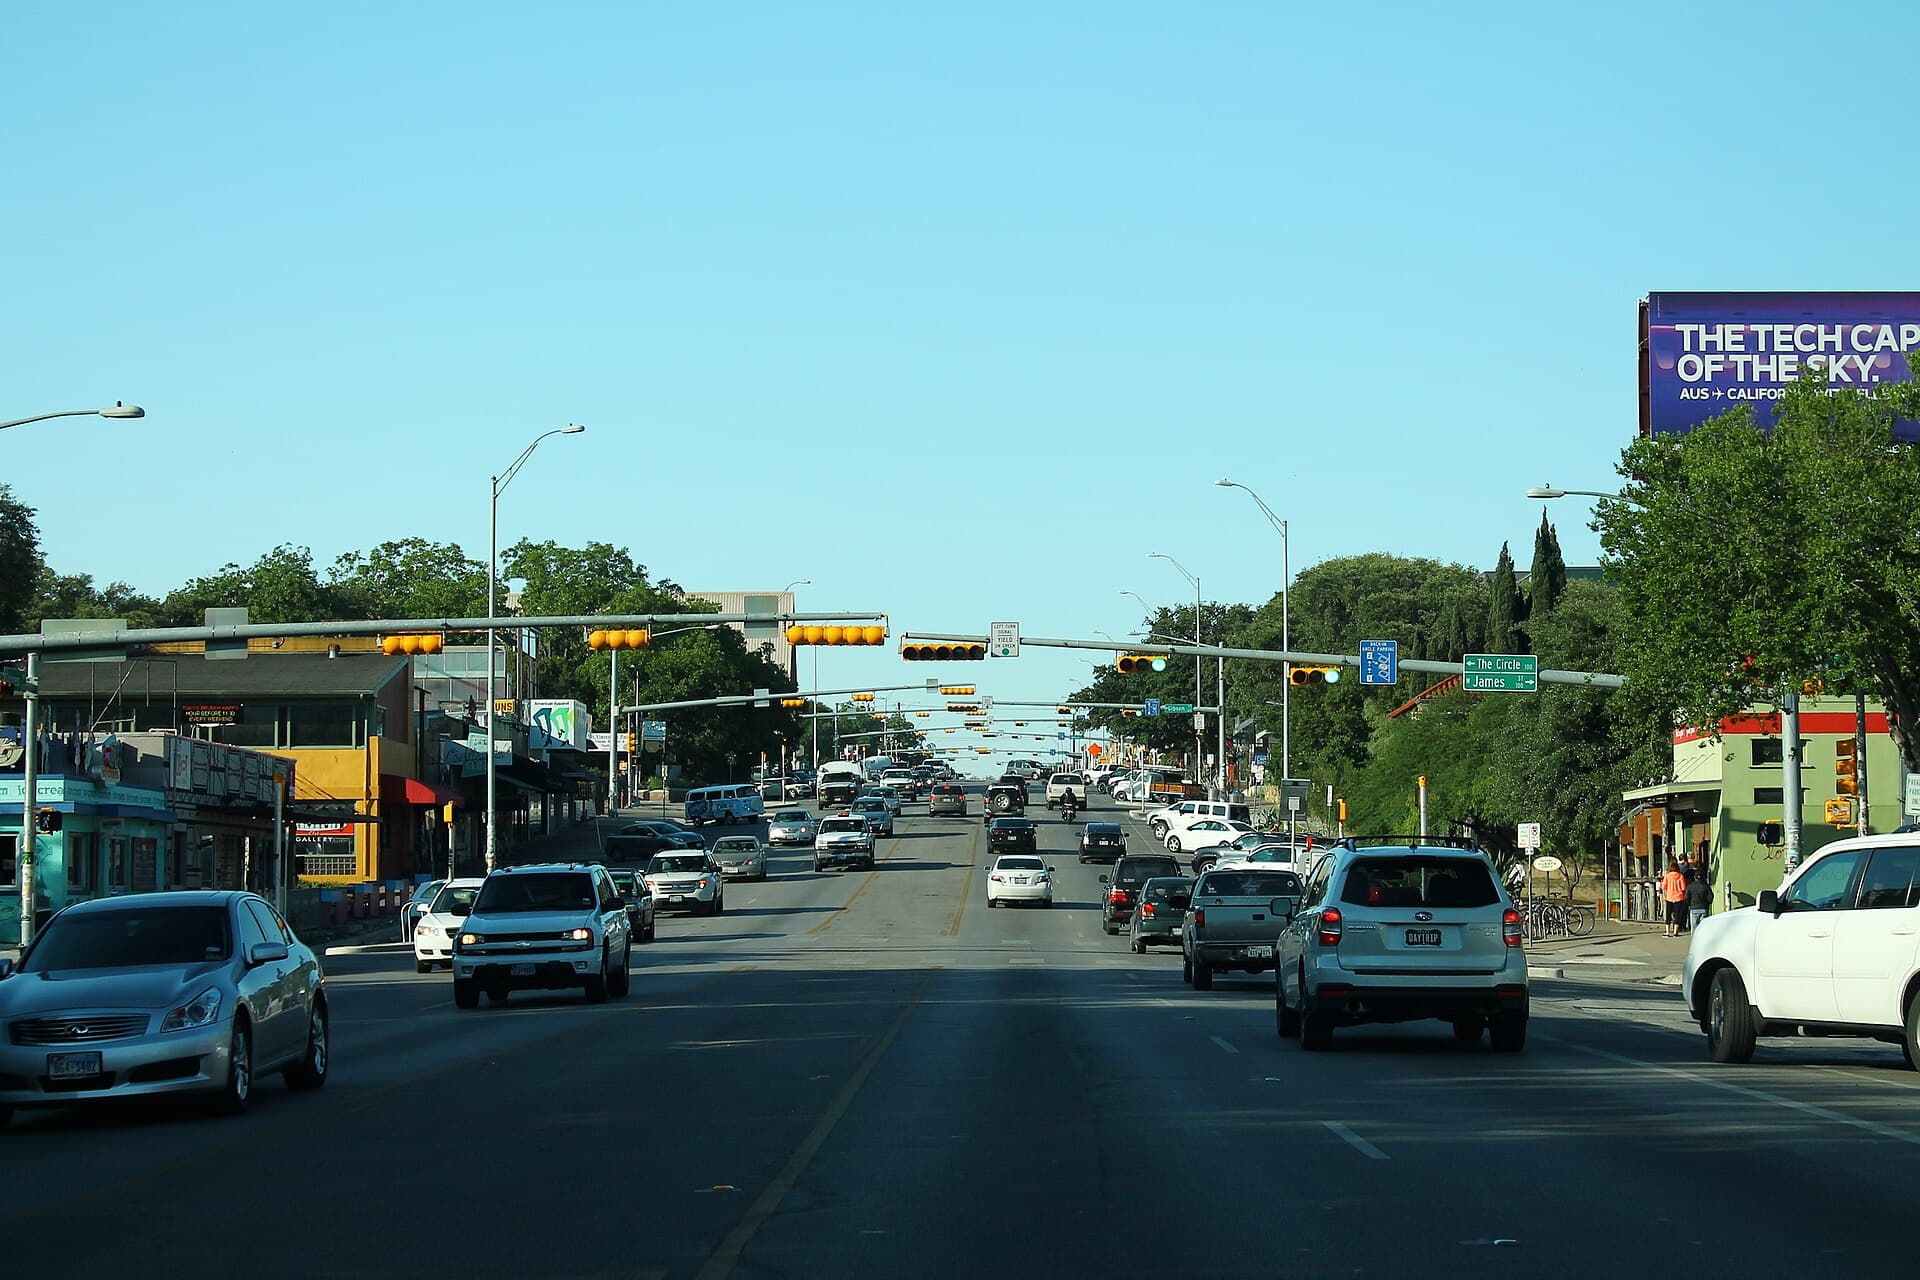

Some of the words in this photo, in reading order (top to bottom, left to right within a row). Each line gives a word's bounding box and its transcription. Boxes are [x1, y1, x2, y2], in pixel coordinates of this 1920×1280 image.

[1675, 324, 1745, 352] THE
[1750, 324, 1842, 352] TECH
[1850, 324, 1920, 352] CAP
[1677, 354, 1725, 382] OF
[1729, 354, 1799, 382] THE
[1806, 354, 1880, 382] SKY.
[1679, 388, 1709, 400] AUS
[1726, 388, 1797, 400] CALIFOR
[1477, 658, 1493, 670] The
[1496, 658, 1521, 670] Circle
[1473, 675, 1505, 688] James
[1408, 933, 1439, 943] DAYTRIP
